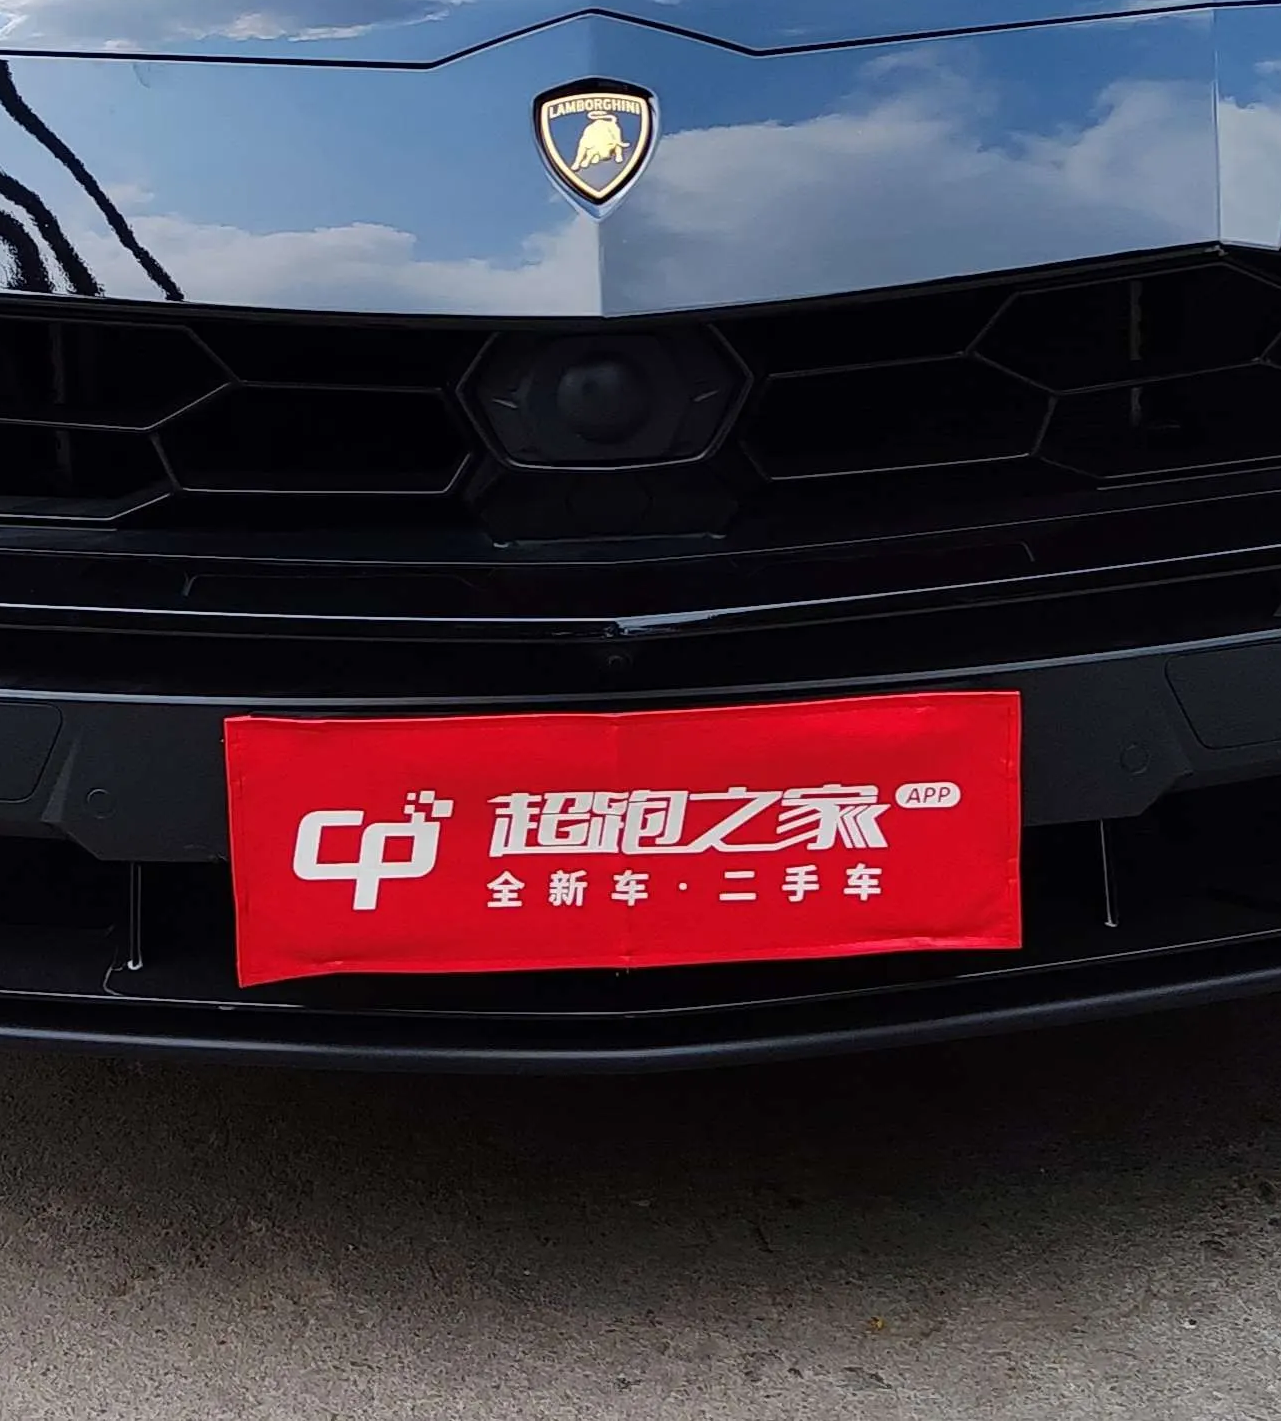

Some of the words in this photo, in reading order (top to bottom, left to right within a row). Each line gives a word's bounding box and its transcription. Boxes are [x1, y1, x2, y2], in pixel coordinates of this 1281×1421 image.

[549, 98, 640, 119] LAMBORGHINI
[487, 784, 891, 858] 超跑之家
[905, 786, 952, 805] APP
